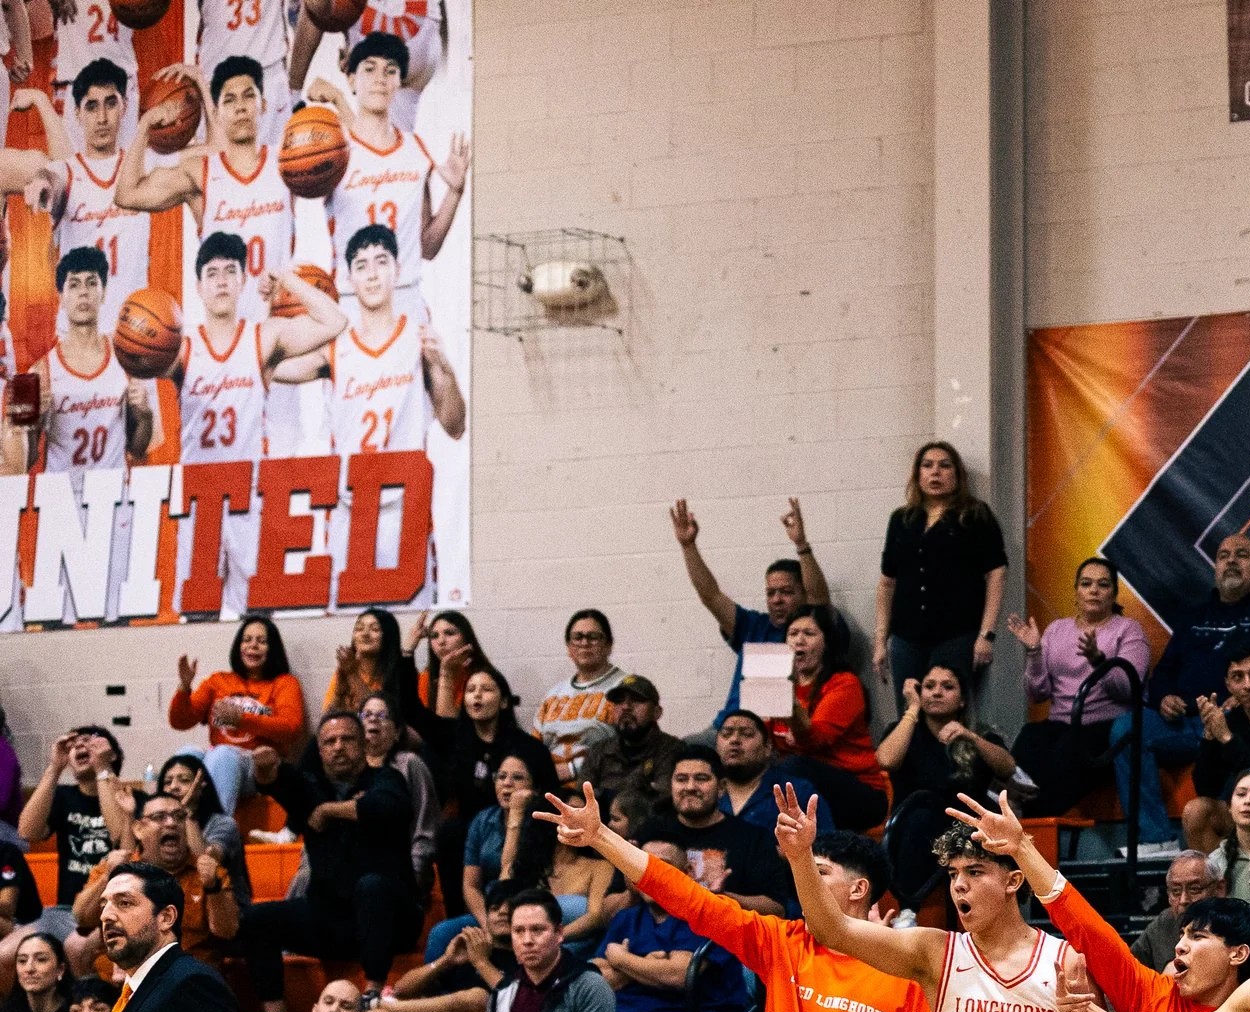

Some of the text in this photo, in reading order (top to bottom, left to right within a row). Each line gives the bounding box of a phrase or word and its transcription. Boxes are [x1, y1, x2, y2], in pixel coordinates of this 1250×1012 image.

[71, 425, 109, 466] 20
[200, 405, 237, 449] 23
[359, 407, 395, 454] 21
